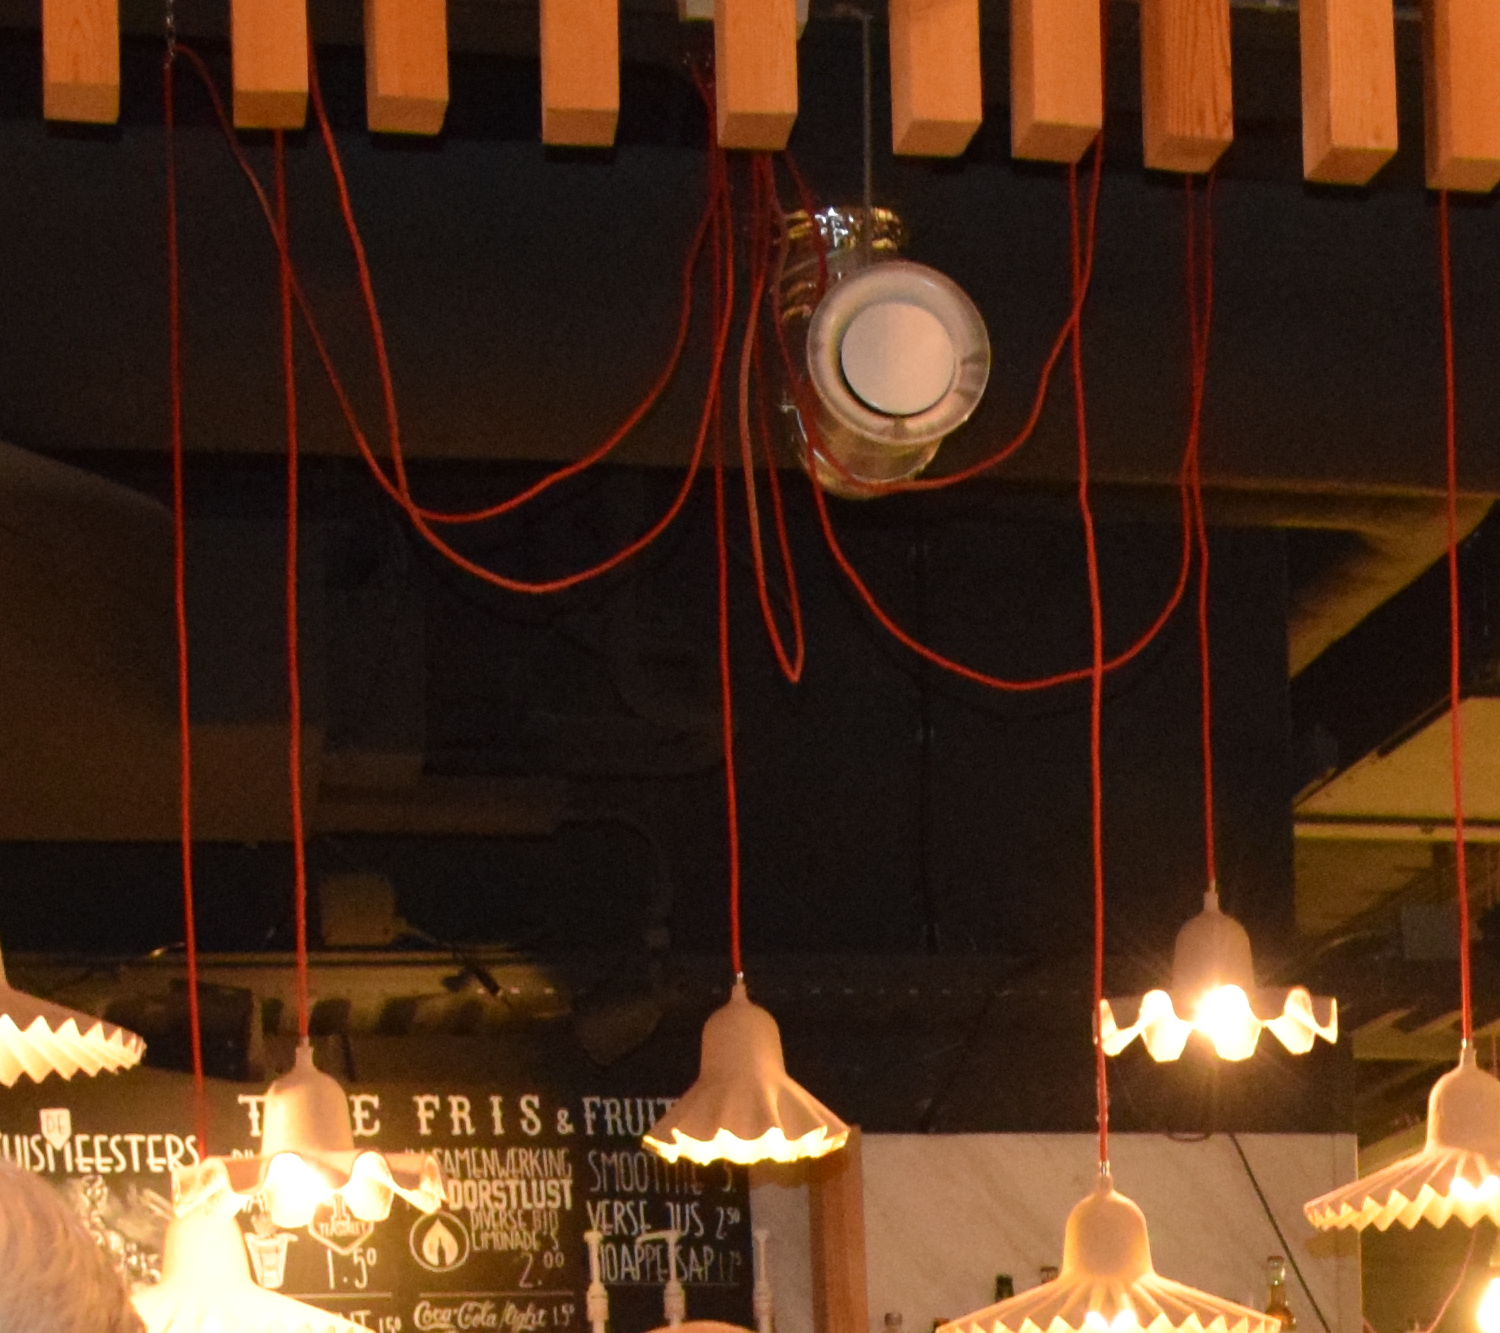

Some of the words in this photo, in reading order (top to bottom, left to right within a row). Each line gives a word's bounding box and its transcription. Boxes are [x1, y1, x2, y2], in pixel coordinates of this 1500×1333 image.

[238, 1094, 381, 1137] TE
[413, 1094, 542, 1137] FRIS
[556, 1108, 575, 1135] &
[448, 1179, 573, 1211] DORSTLUST
[586, 1199, 653, 1237] VERSE
